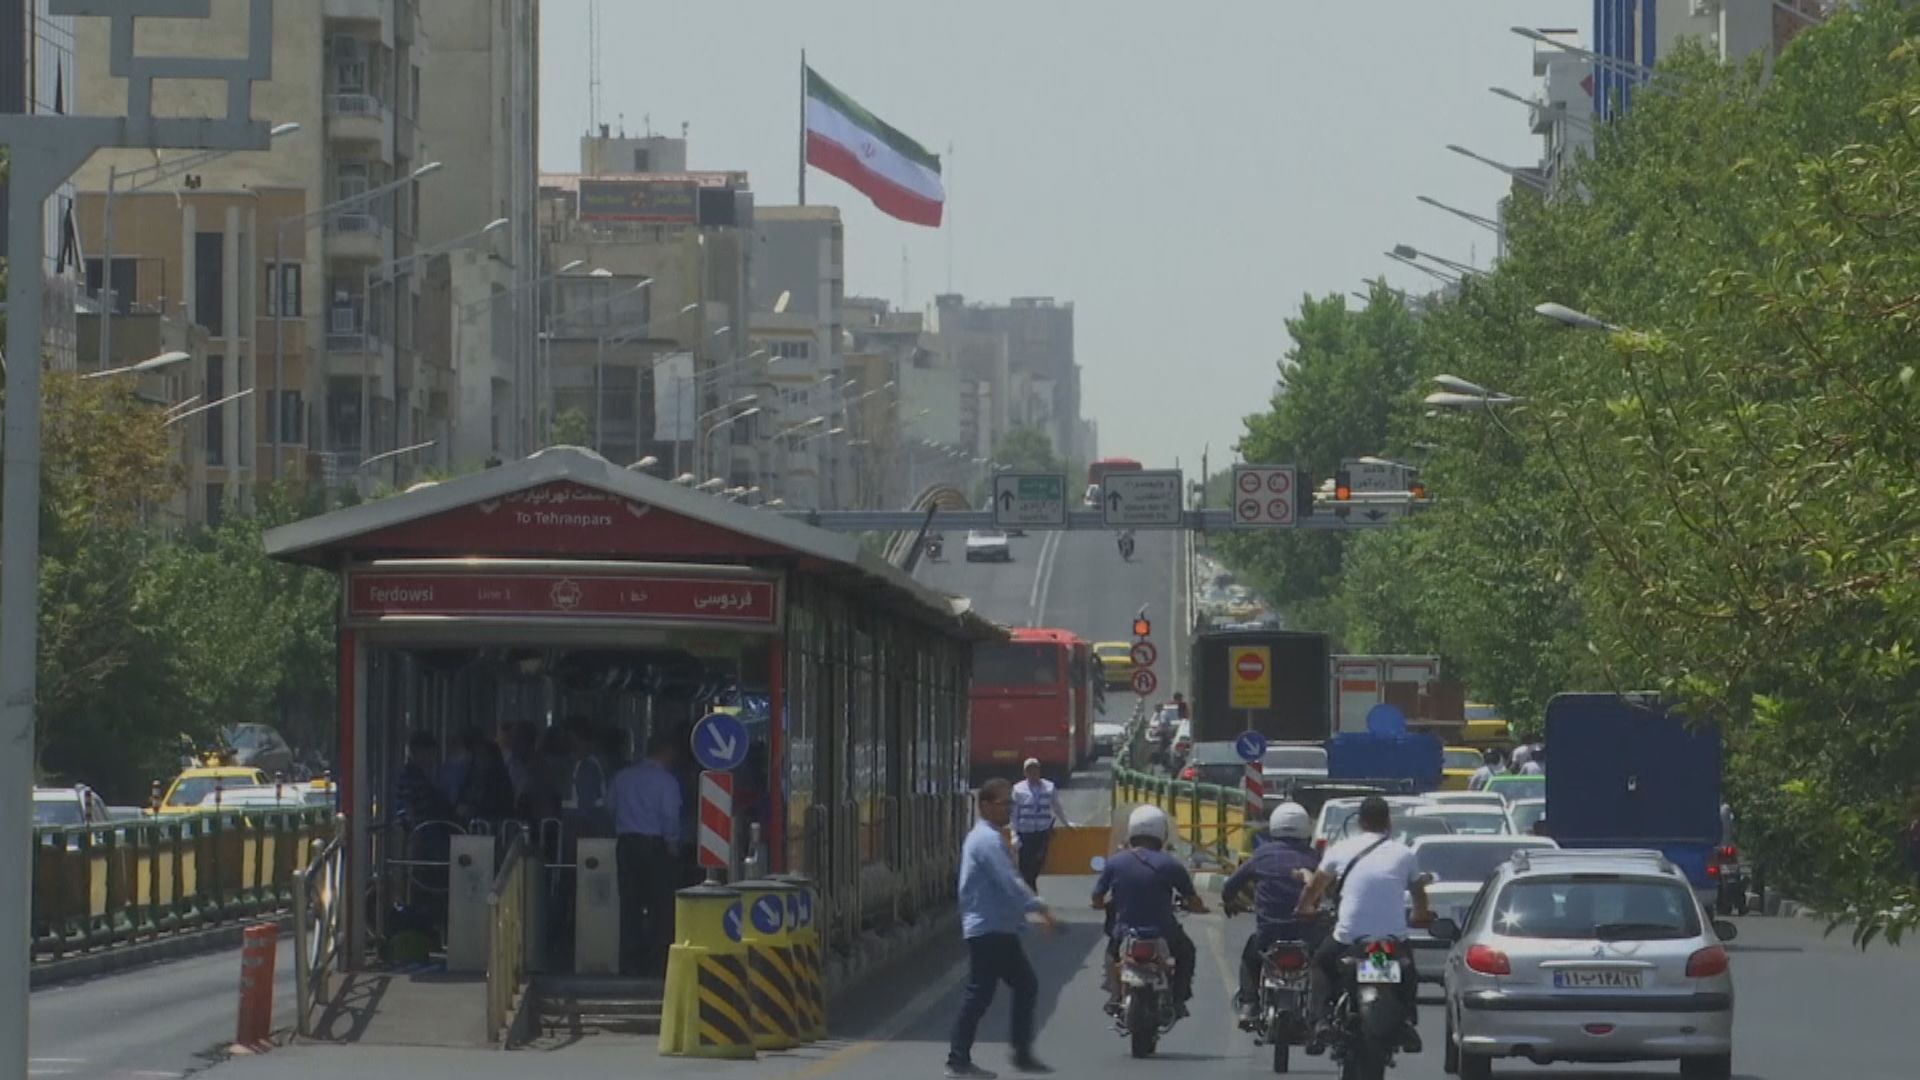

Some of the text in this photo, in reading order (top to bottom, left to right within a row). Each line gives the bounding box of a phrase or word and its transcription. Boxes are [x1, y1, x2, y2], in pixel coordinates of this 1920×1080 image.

[516, 512, 612, 527] To Tehranpars
[370, 586, 433, 602] Ferdowsi
[479, 590, 501, 601] Line
[631, 590, 649, 602] خط
